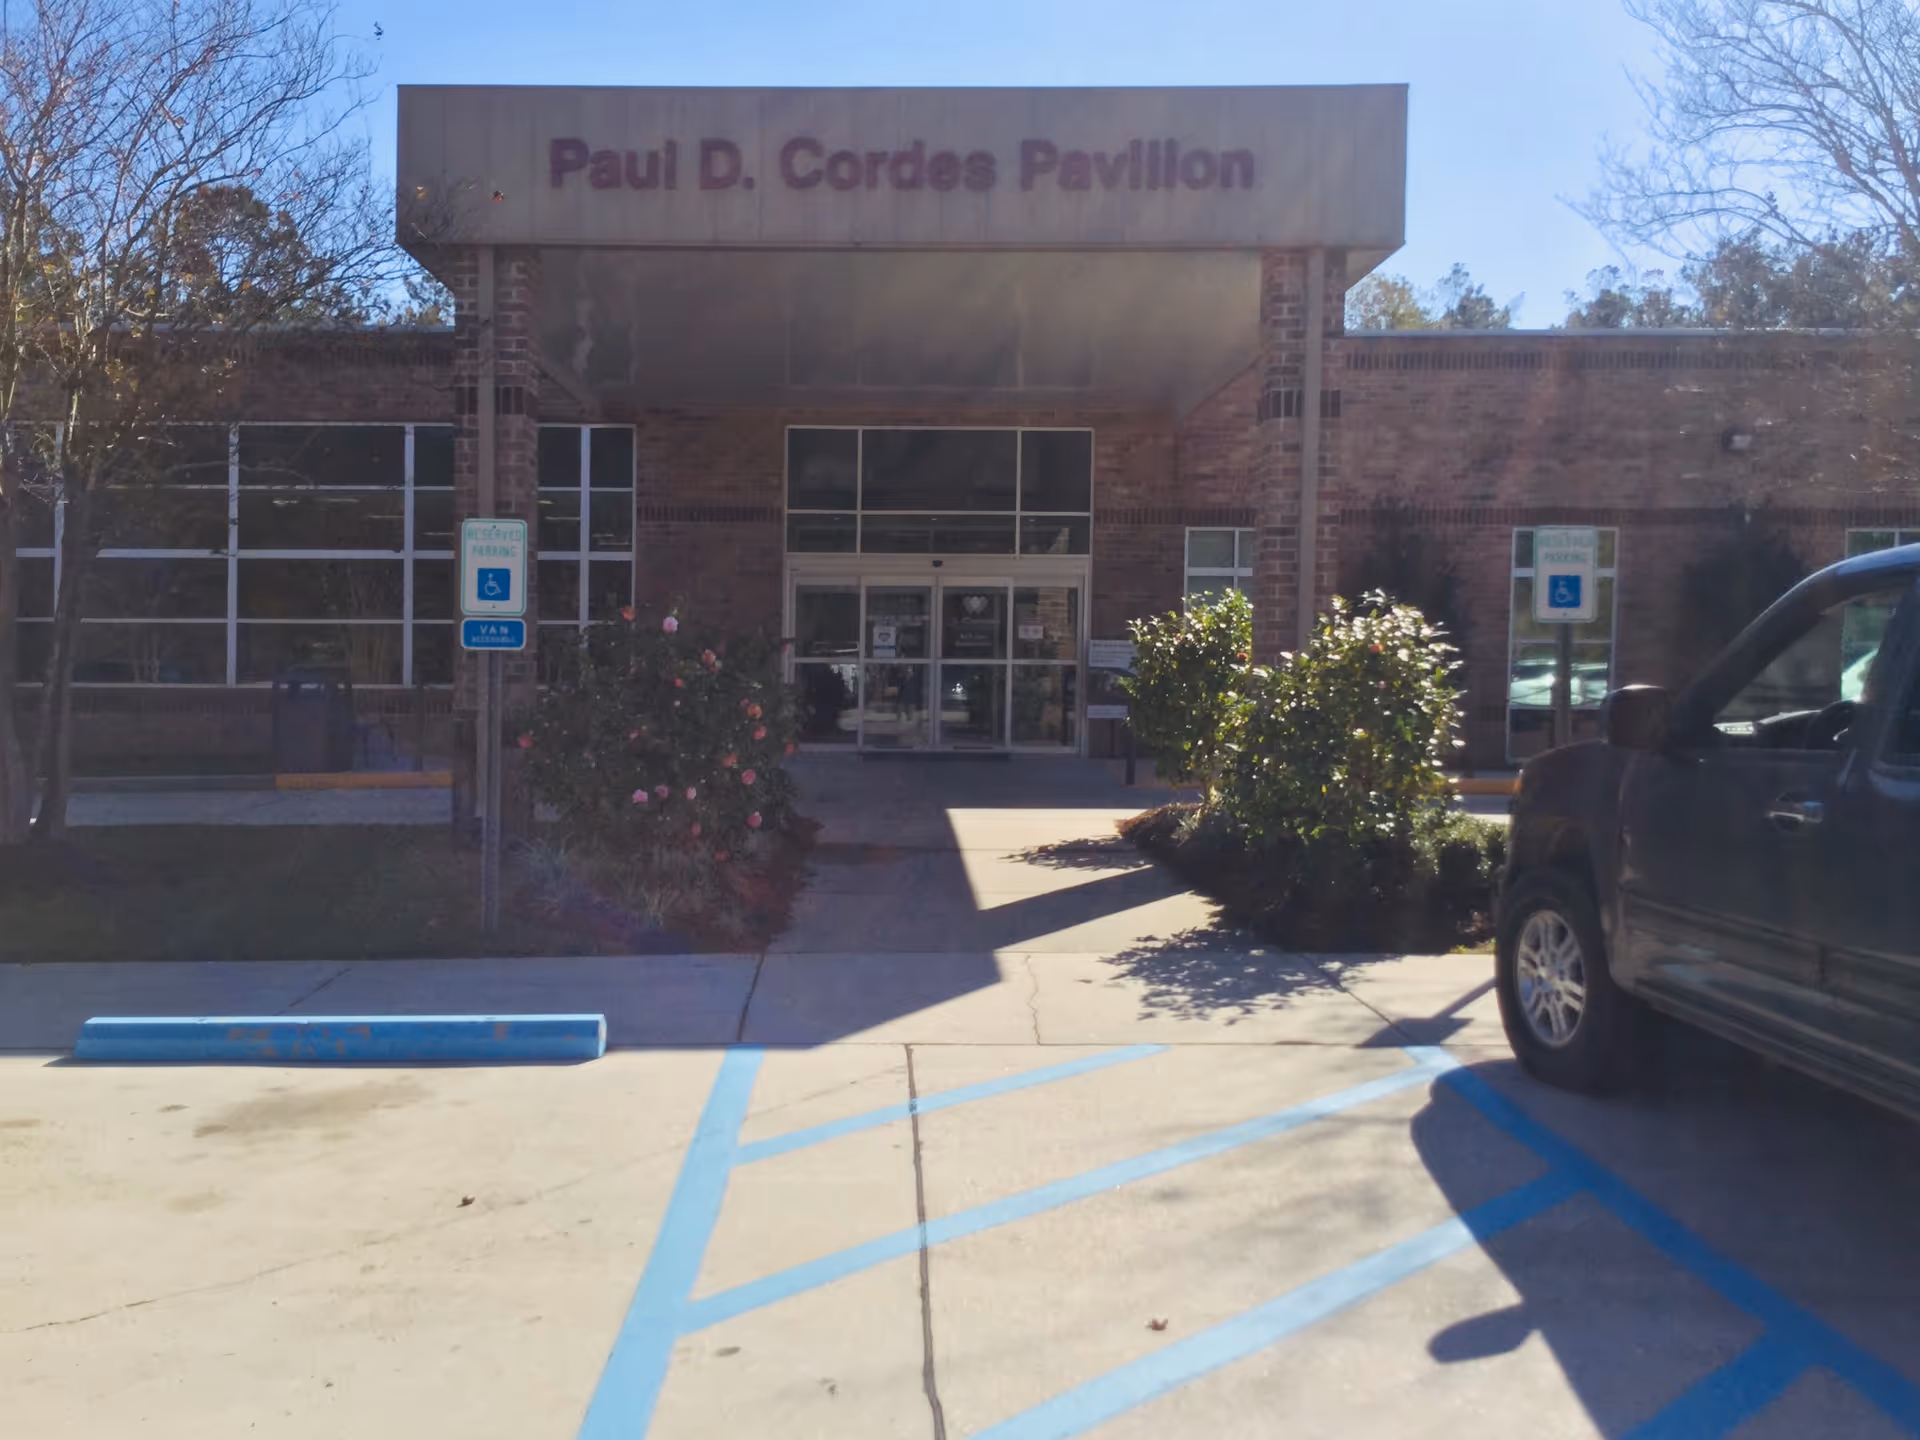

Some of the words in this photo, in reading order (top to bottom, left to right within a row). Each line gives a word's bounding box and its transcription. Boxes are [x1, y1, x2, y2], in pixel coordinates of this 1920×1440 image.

[550, 138, 678, 190] Paul
[699, 138, 755, 190] D.
[779, 137, 998, 191] Cordes
[1020, 138, 1254, 191] Pavilion
[480, 624, 509, 635] VAN
